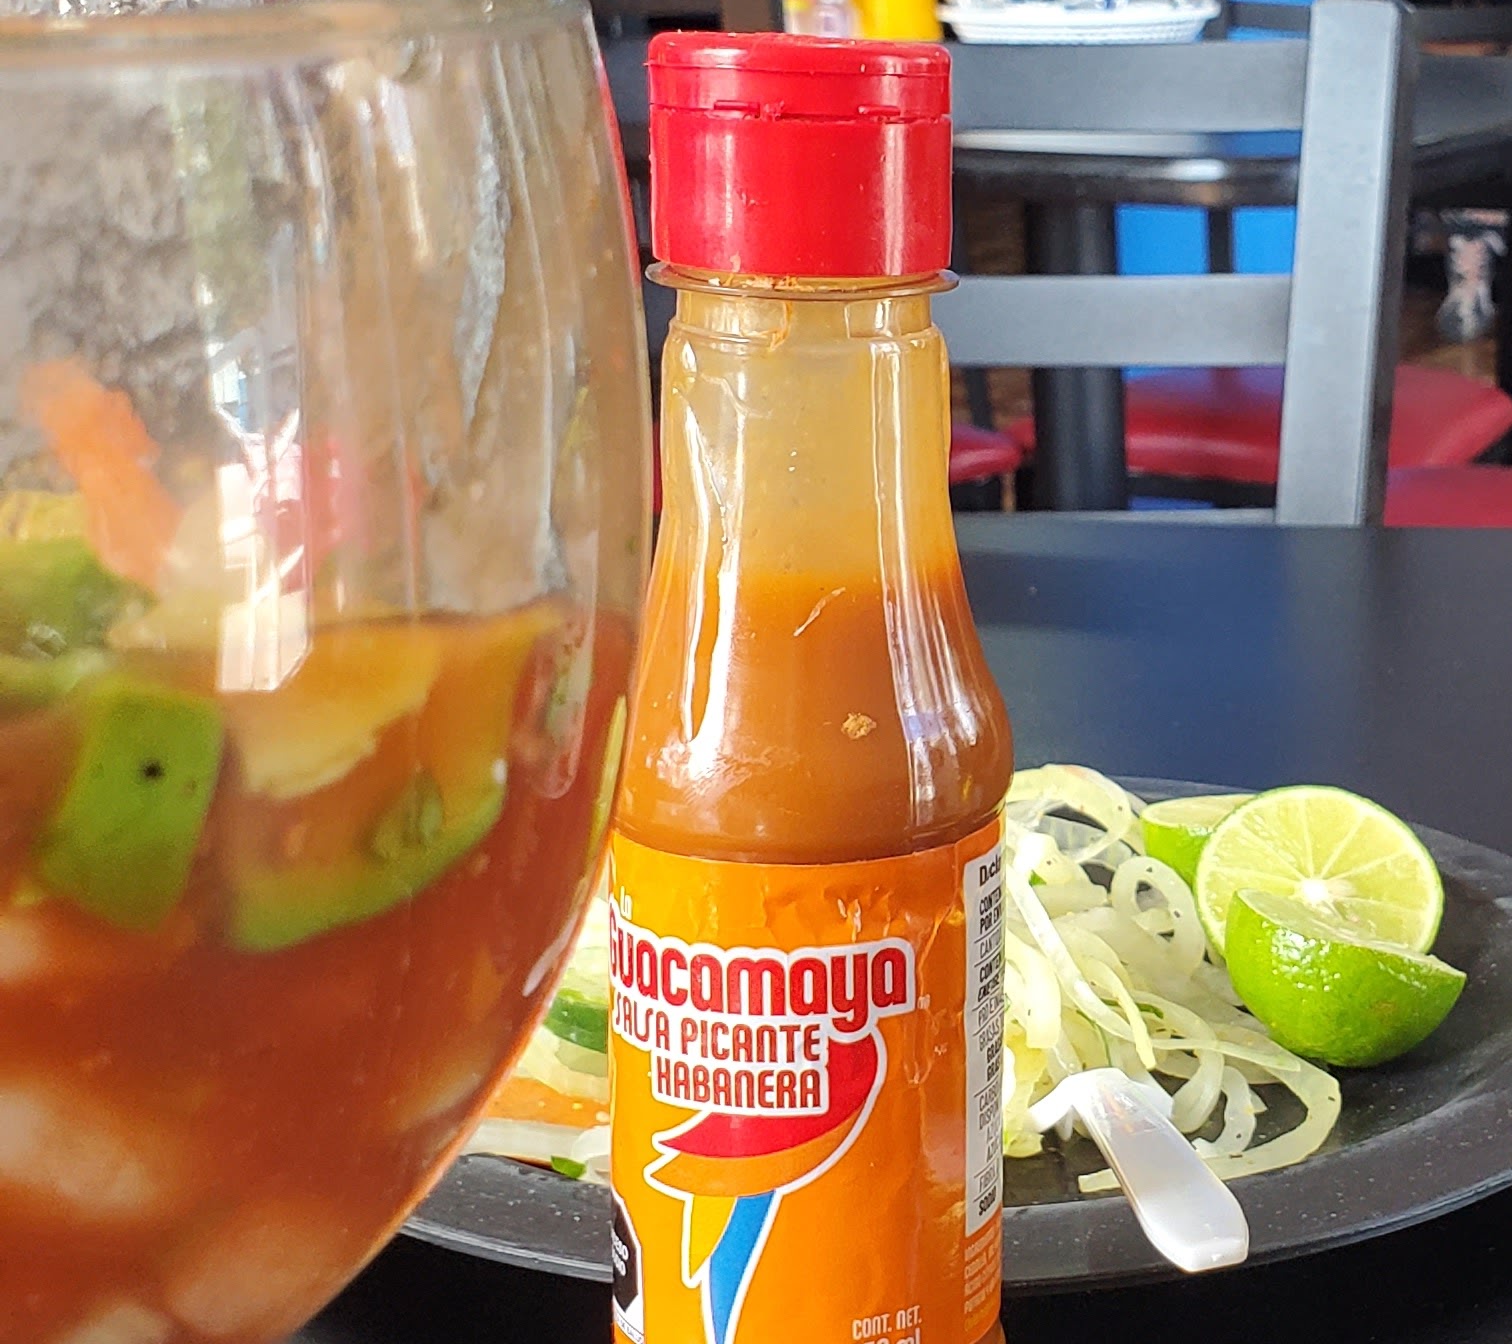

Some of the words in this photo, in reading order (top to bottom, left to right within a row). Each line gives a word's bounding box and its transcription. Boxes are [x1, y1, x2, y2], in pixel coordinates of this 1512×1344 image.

[616, 992, 671, 1052] SALSA
[681, 1016, 821, 1065] PICANTE
[656, 1055, 821, 1109] HABANERA
[852, 1313, 893, 1341] CONT.
[895, 1304, 923, 1331] NET.
